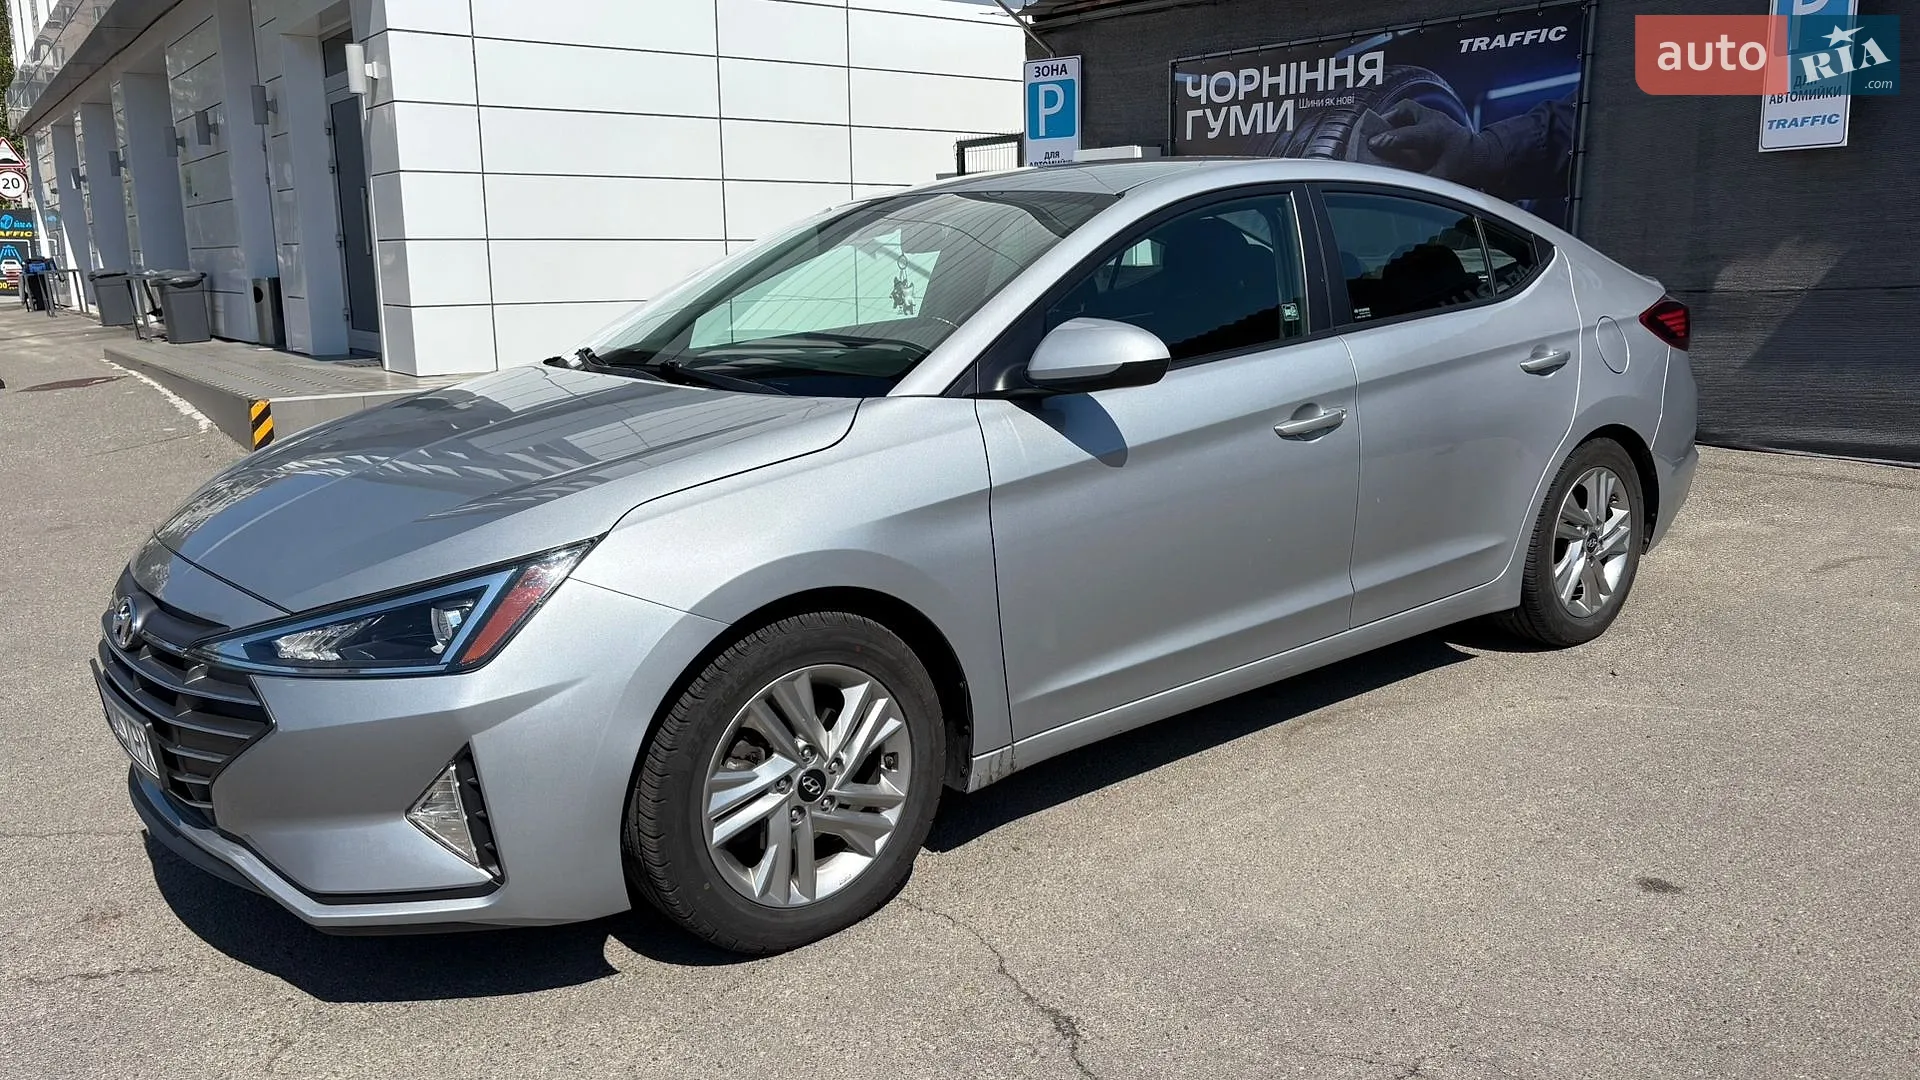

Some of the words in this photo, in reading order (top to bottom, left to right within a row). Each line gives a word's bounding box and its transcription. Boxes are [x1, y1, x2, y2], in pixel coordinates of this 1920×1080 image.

[1459, 25, 1568, 53] TRAFFIC
[1034, 63, 1068, 78] ЗОНА
[1186, 50, 1385, 105] ЧОРНІННЯ
[1298, 98, 1324, 109] Шини
[1325, 97, 1335, 107] як
[1336, 93, 1355, 106] нові
[1769, 85, 1842, 105] АВТОМИЙКИ
[1038, 83, 1064, 137] P
[1186, 99, 1294, 141] ГУМИ
[1767, 113, 1840, 130] TRAFFIC
[1044, 150, 1060, 160] ДЛЯ
[2, 177, 20, 190] 20
